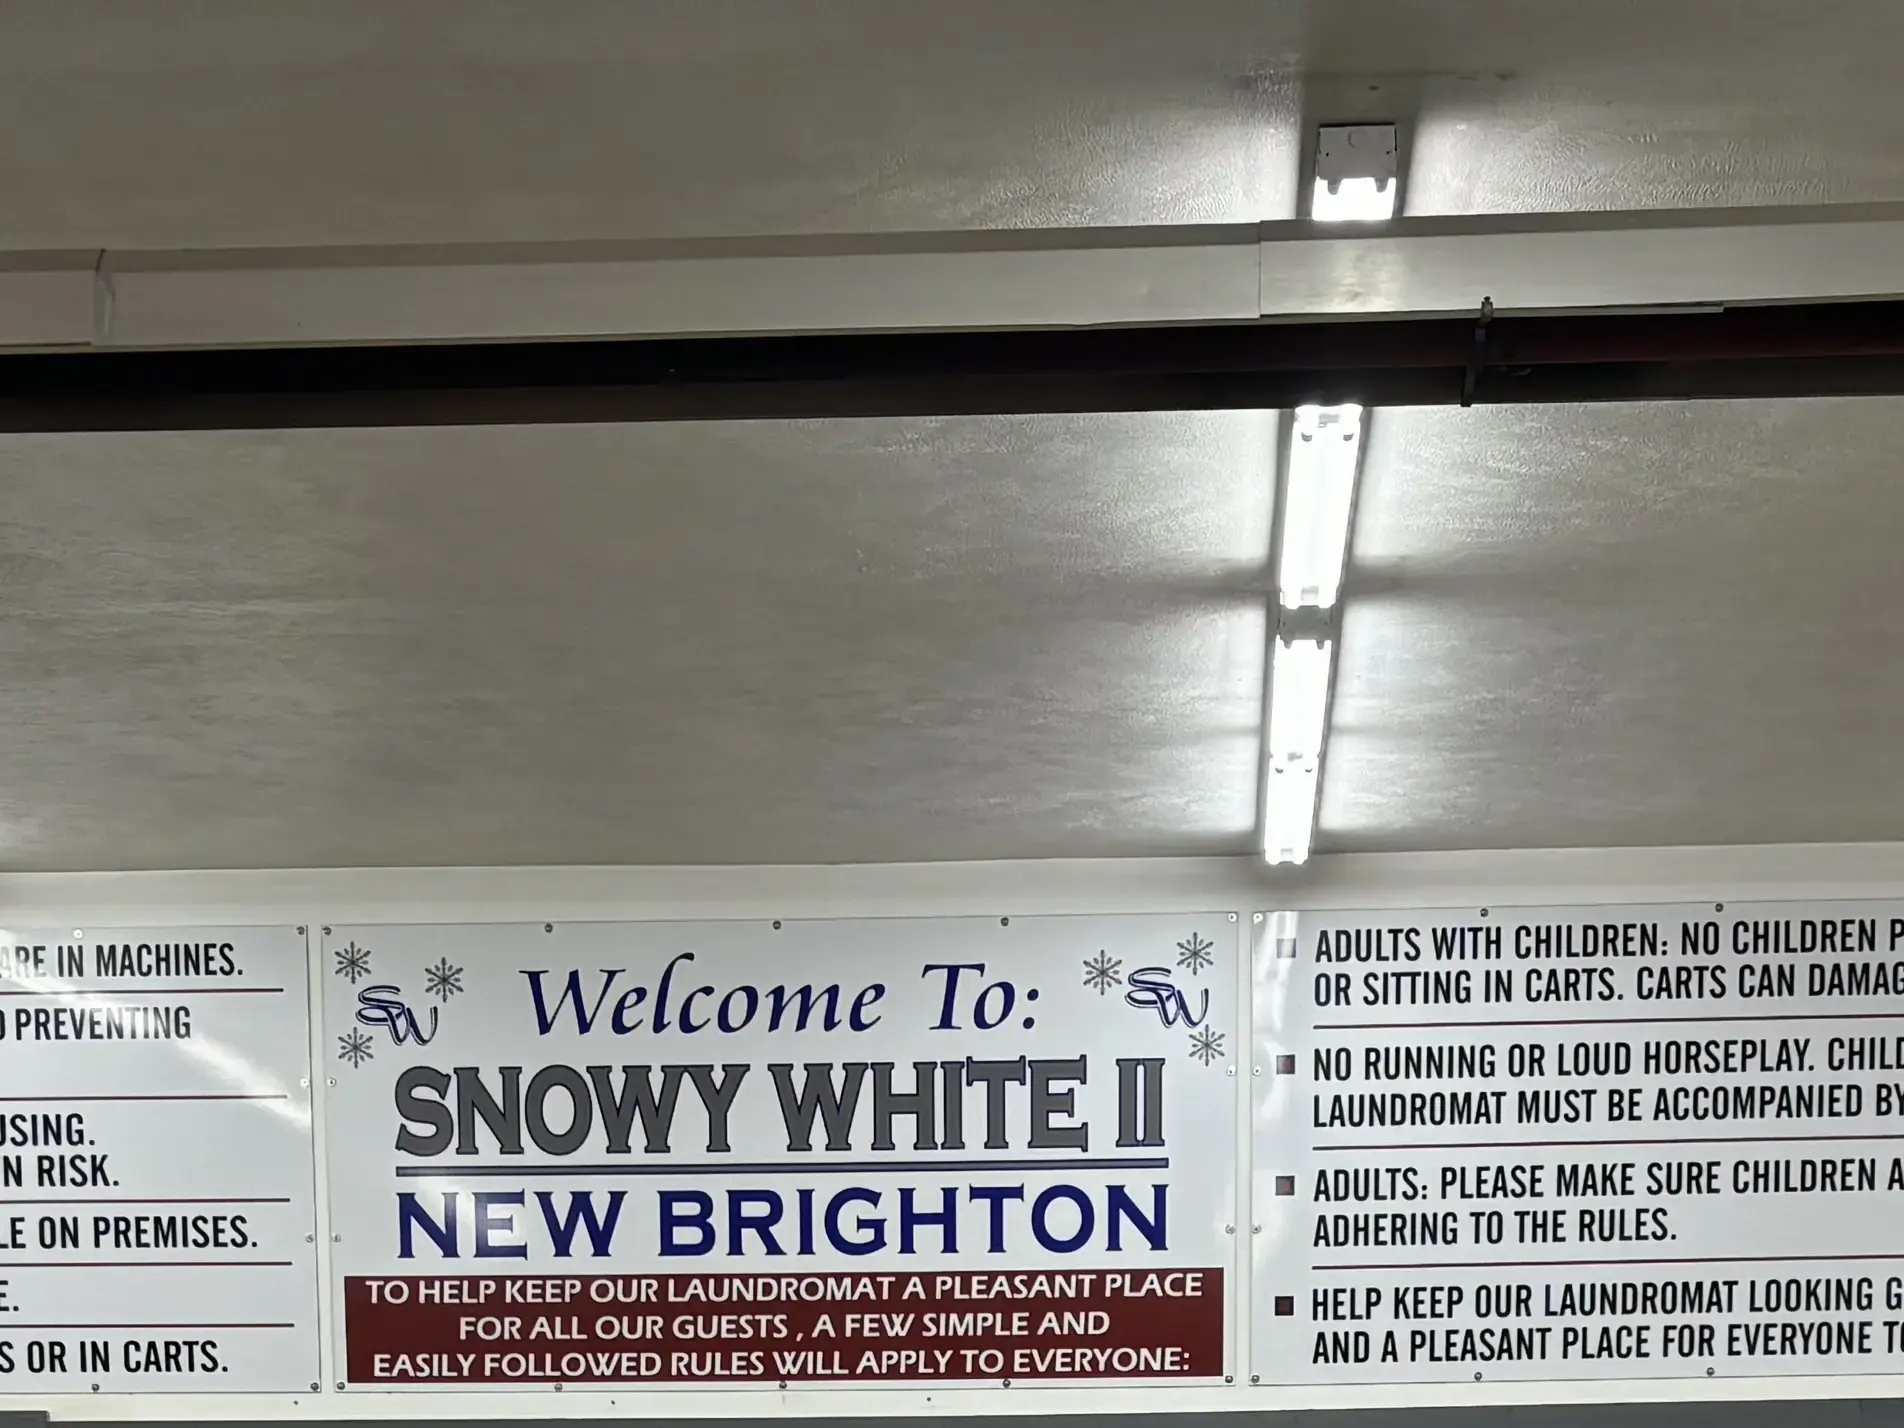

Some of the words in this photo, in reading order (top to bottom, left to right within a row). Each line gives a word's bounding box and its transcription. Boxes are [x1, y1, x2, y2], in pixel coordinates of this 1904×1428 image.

[518, 952, 885, 1035] Welcome
[922, 963, 1038, 1030] To:
[1314, 1048, 1351, 1081] NO
[1365, 1044, 1495, 1080] RUNNING
[1509, 1044, 1545, 1077] OR
[1558, 1042, 1631, 1076] LOUD
[1644, 1038, 1814, 1074] HORSEPLAY.
[395, 1064, 750, 1157] SNOWY
[767, 1054, 1088, 1152] WHITE
[1116, 1058, 1165, 1147] II
[396, 1188, 628, 1260] NEW
[657, 1183, 1168, 1256] BRIGHTON
[1313, 1212, 1457, 1247] ADHERING
[1469, 1211, 1503, 1244] TO
[1514, 1210, 1566, 1243] THE
[1579, 1208, 1676, 1242] RULES.
[365, 1281, 409, 1304] TO
[419, 1280, 496, 1303] HELP
[506, 1280, 581, 1303] KEEP
[590, 1279, 658, 1302] OUR
[668, 1277, 895, 1302] LAUNDROMAT
[902, 1277, 926, 1299] A
[936, 1275, 1097, 1299] PLEASANT
[1105, 1273, 1203, 1297] PLACE
[1313, 1288, 1381, 1321] HELP
[1394, 1286, 1463, 1319] KEEP
[1476, 1285, 1531, 1318] OUR
[1545, 1280, 1739, 1316] LAUNDROMAT
[1750, 1277, 1872, 1312] LOOKING
[460, 1317, 521, 1340] FOR
[529, 1316, 587, 1339] ALL
[595, 1316, 663, 1339] OUR
[812, 1314, 835, 1337] A
[846, 1313, 915, 1337] FEW
[922, 1312, 1029, 1336] SIMPLE
[1037, 1311, 1109, 1335] AND
[1313, 1331, 1369, 1364] AND
[1381, 1330, 1398, 1362] A
[1411, 1328, 1552, 1362] PLEASANT
[1563, 1325, 1650, 1359] PLACE
[1663, 1324, 1714, 1357] FOR
[1728, 1321, 1872, 1356] EVERYONE
[28, 1341, 67, 1373] OR
[80, 1341, 110, 1372] IN
[124, 1340, 228, 1373] CARTS.
[374, 1354, 476, 1377] EASILY
[485, 1353, 661, 1376] FOLLOWED
[671, 1352, 764, 1375] RULES
[772, 1351, 849, 1374] WILL
[856, 1350, 953, 1374] APPLY
[960, 1350, 1004, 1373] TO
[1014, 1347, 1189, 1372] EVERYONE:
